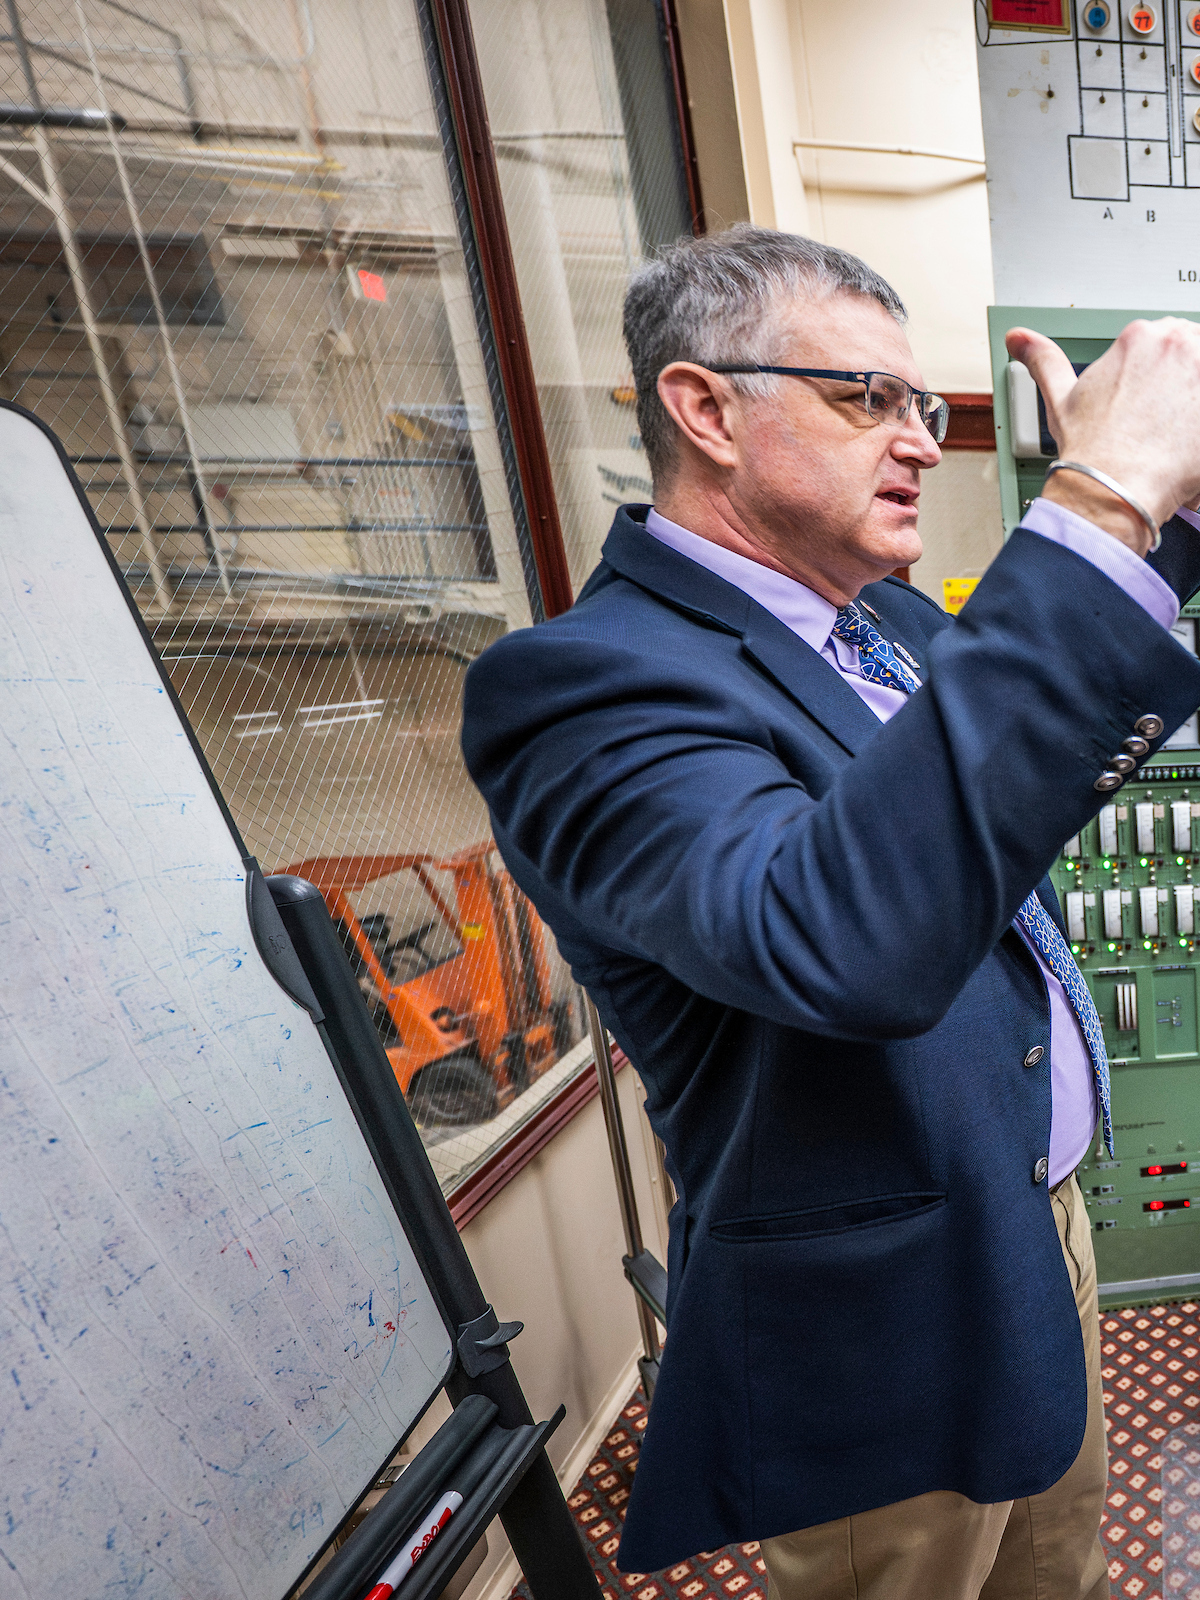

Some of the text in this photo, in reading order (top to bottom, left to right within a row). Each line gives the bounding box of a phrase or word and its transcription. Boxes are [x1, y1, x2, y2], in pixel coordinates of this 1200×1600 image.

[1135, 16, 1150, 28] 77
[1103, 207, 1114, 220] A
[1146, 210, 1156, 222] B
